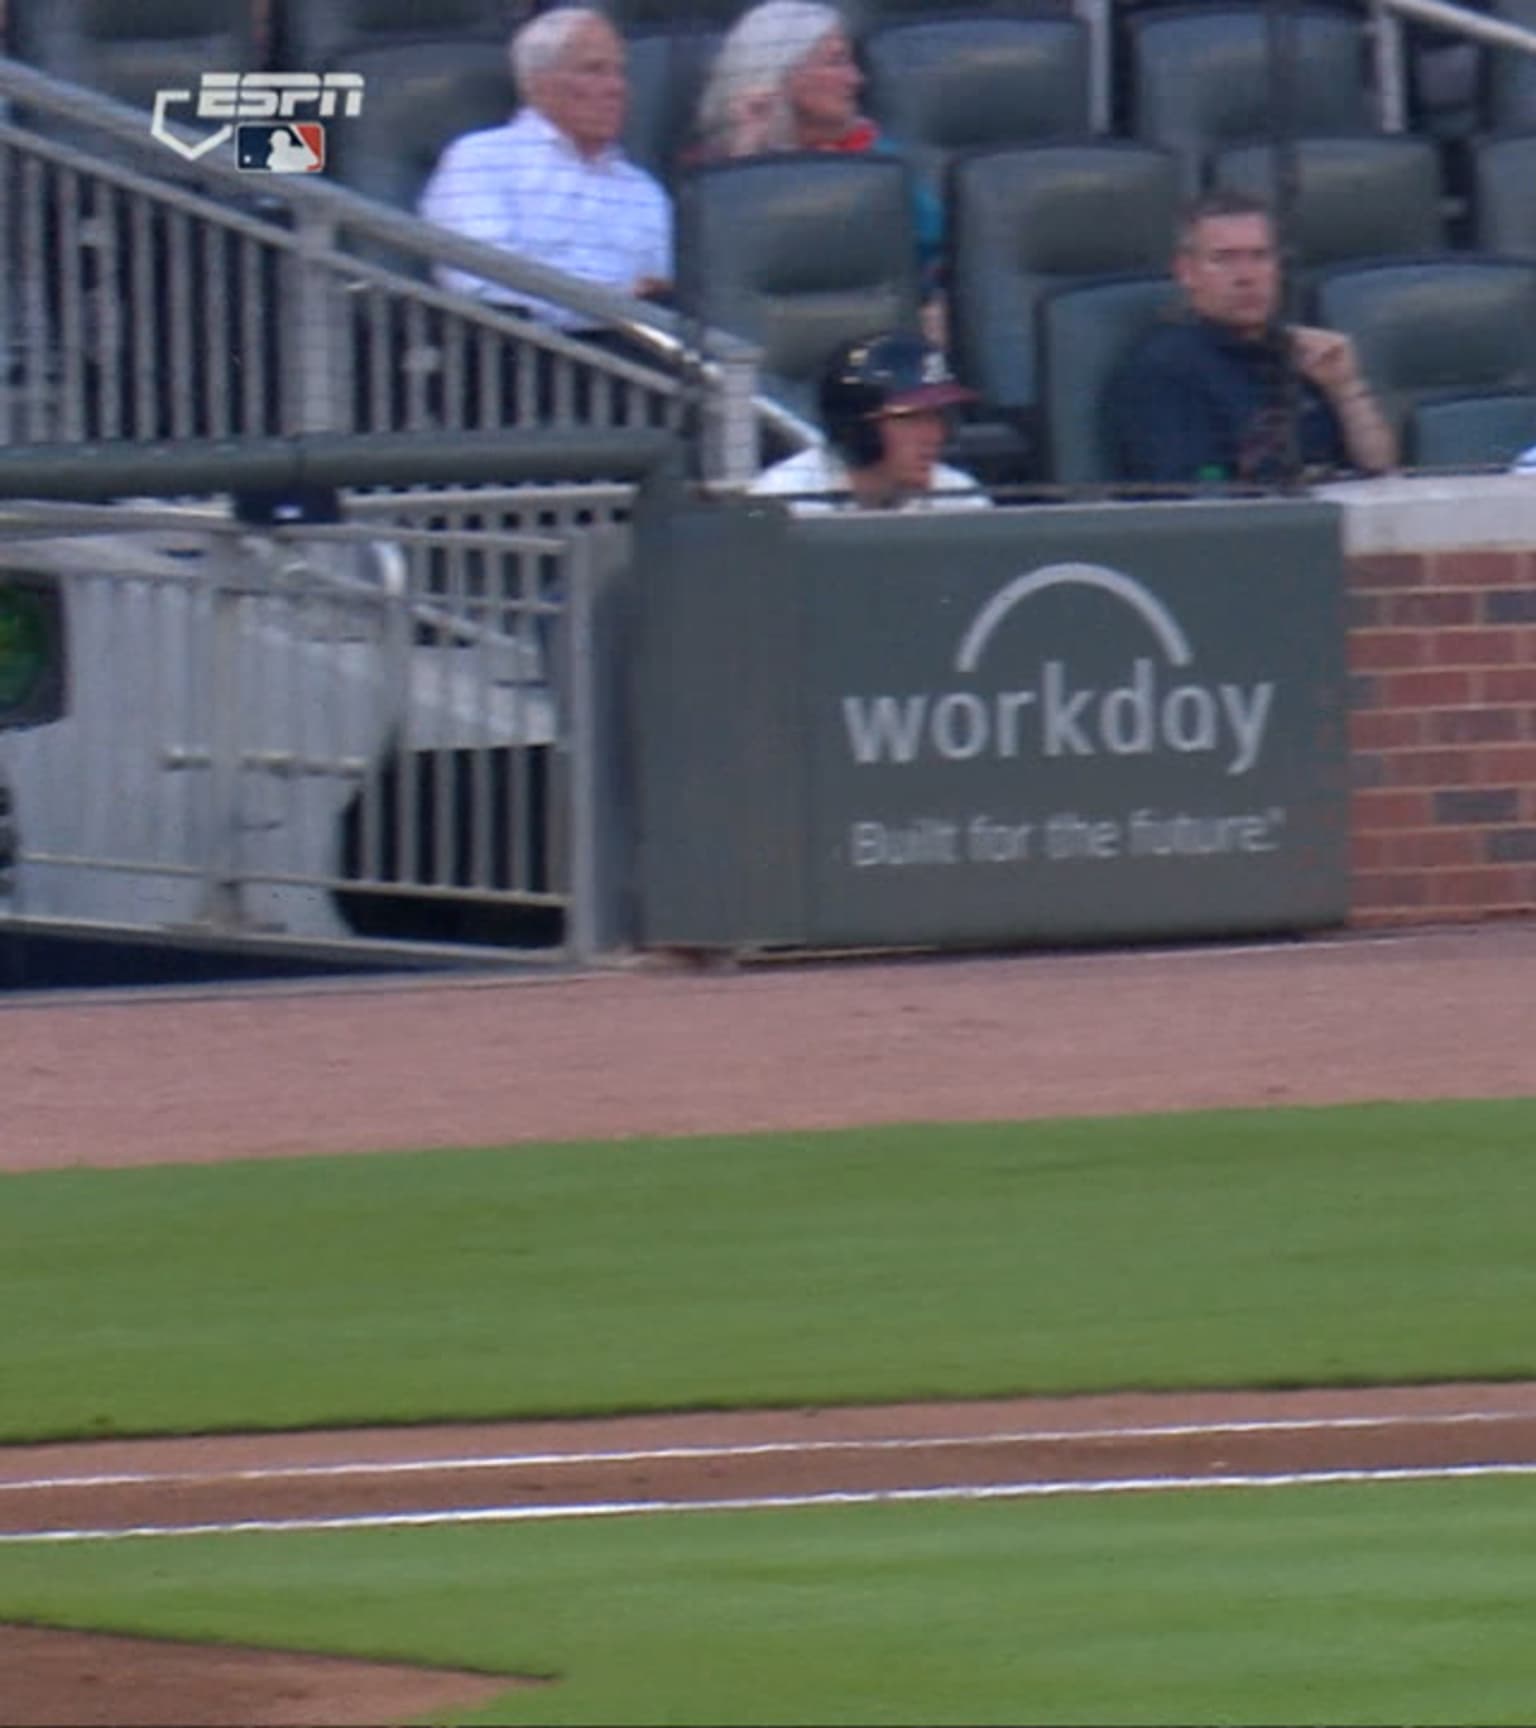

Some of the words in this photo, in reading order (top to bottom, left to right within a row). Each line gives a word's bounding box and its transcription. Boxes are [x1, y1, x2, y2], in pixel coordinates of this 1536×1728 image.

[842, 657, 1275, 774] workday
[851, 819, 958, 866] Built
[968, 815, 1032, 863] for
[1044, 812, 1120, 859] the
